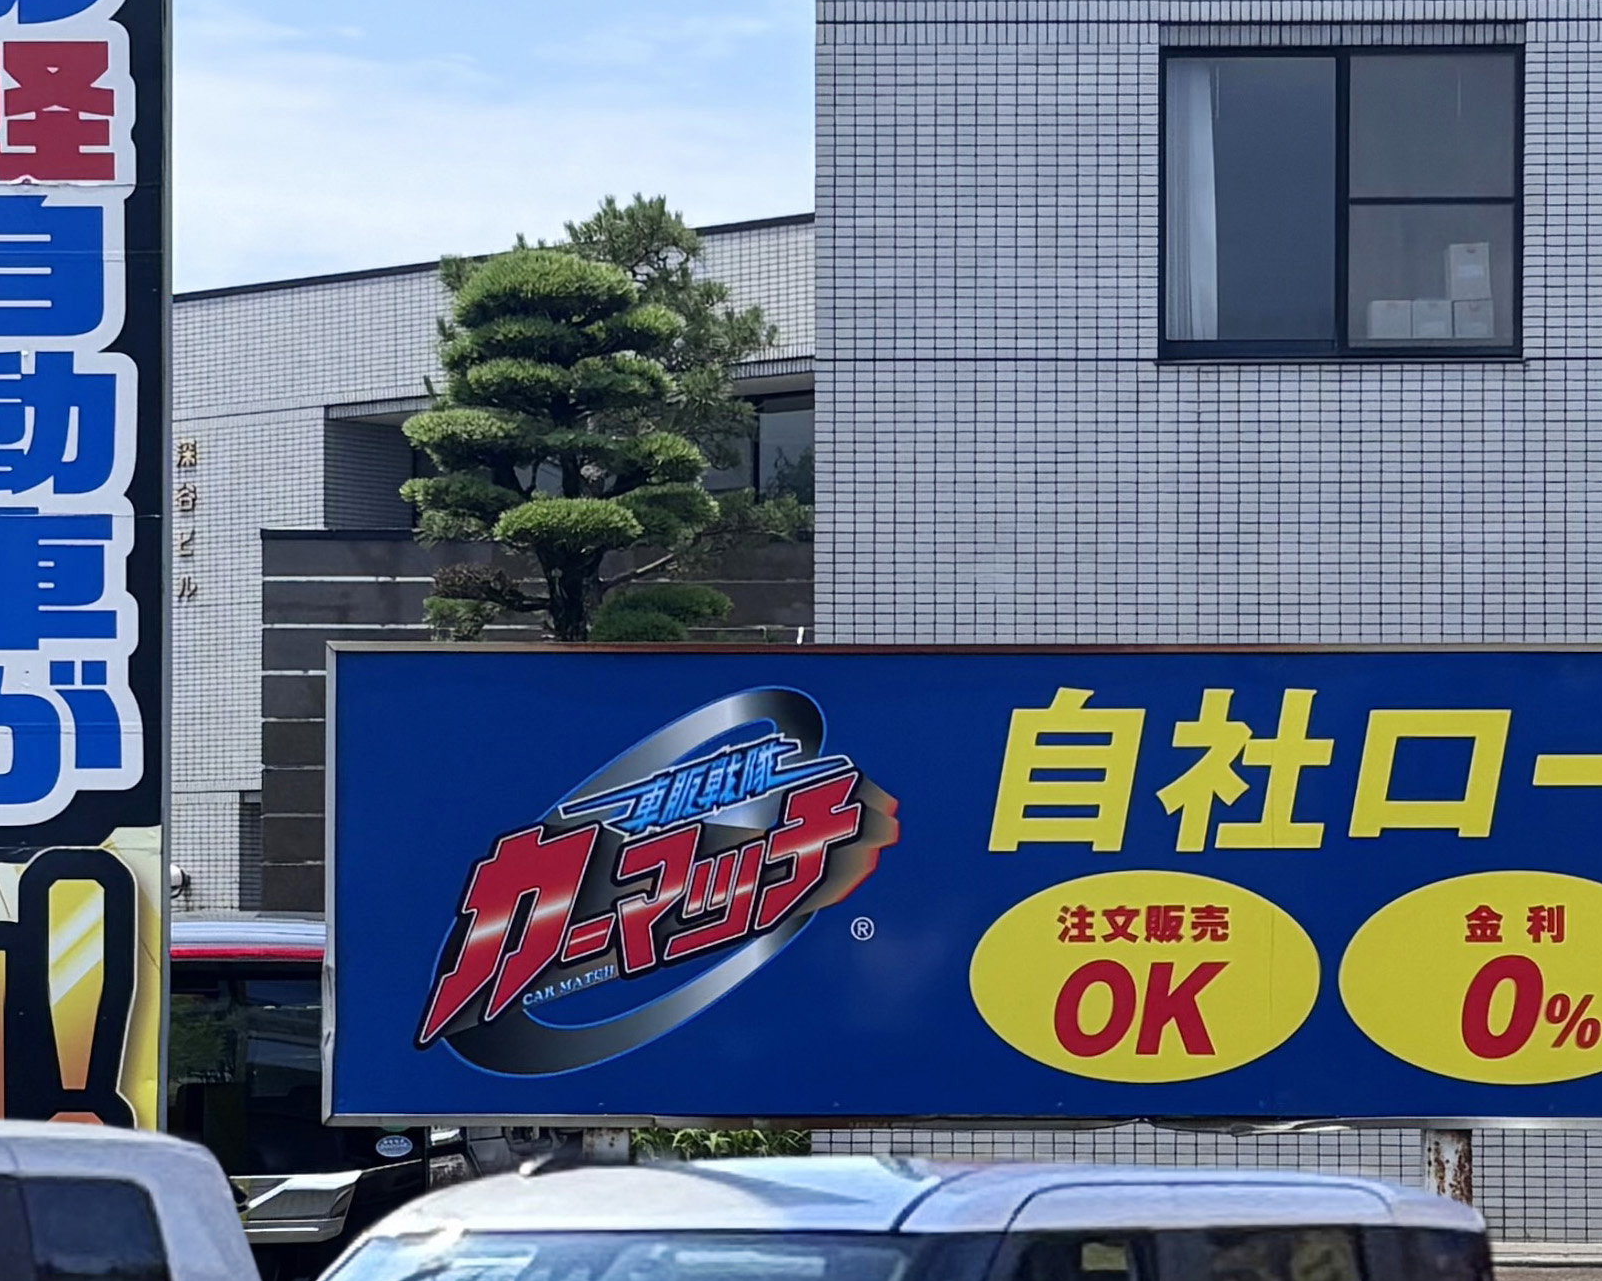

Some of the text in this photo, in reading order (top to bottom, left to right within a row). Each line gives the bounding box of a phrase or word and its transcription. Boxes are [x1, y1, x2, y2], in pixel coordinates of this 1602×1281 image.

[175, 437, 198, 604] 深谷ビル
[418, 770, 862, 1046] カーマッチ
[1056, 904, 1230, 944] 注文販売
[522, 964, 615, 1006] CAR MATCH
[1053, 959, 1229, 1059] OK
[1460, 954, 1602, 1060] 0%
